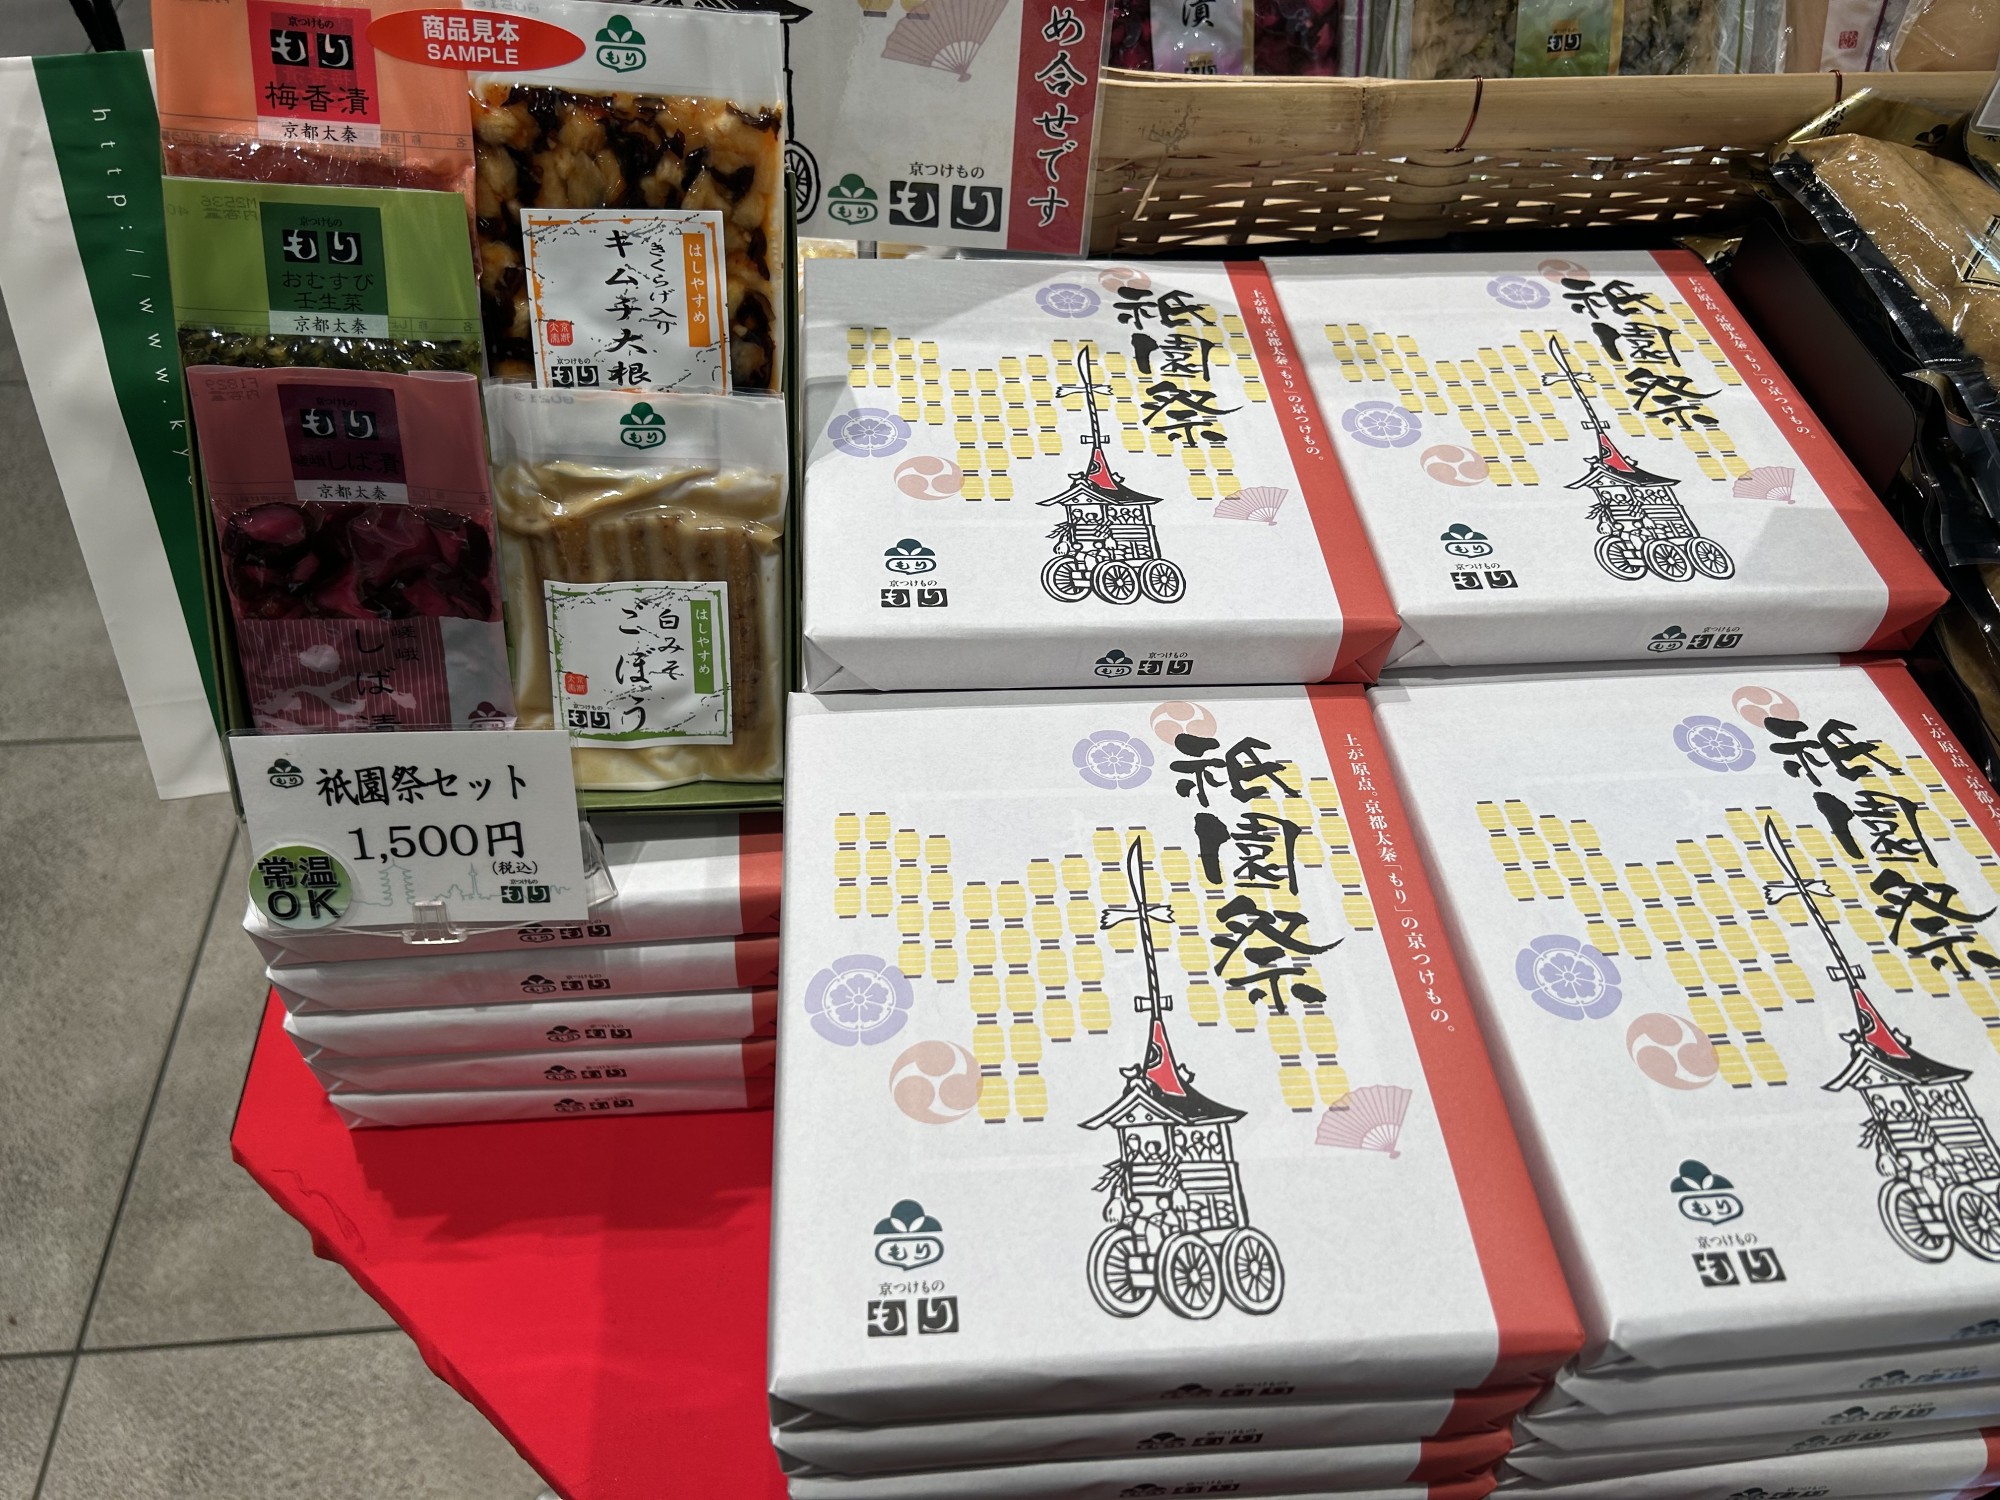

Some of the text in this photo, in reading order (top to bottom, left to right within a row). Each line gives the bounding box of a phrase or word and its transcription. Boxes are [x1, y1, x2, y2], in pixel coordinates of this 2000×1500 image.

[288, 15, 334, 29] 京つけもの
[422, 15, 520, 45] 商品見本
[270, 28, 354, 70] もり
[427, 43, 519, 65] SAMPLE
[605, 50, 637, 66] もり
[265, 81, 370, 115] 梅香漬
[1027, 5, 1087, 227] め合せです
[281, 121, 358, 144] 京都太秦
[909, 161, 985, 179] 京つけもの
[837, 206, 869, 219] もり
[889, 180, 1003, 233] もり
[300, 216, 342, 227] 京つけもの
[282, 229, 363, 265] もり
[282, 271, 374, 291] おむすび
[649, 238, 677, 335] きくらげ入り
[689, 244, 706, 324] はしやすめ
[294, 292, 363, 311] 壬生菜
[604, 230, 652, 385] キムチ大根
[294, 315, 368, 334] 京都太秦
[556, 356, 591, 365] 京つけもの
[1561, 277, 1722, 431] 祇園祭
[551, 365, 599, 387] もり
[1113, 286, 1244, 447] 祇園祭
[301, 409, 379, 441] もり
[317, 484, 387, 501] 京都太秦
[1454, 562, 1500, 570] 京つけもの
[889, 579, 937, 588] 京つけもの
[1450, 570, 1519, 591] もり
[880, 588, 948, 608] もり
[659, 608, 684, 680] 白みそ
[696, 608, 711, 675] はしやすめ
[1686, 633, 1743, 650] もり
[615, 600, 655, 731] ごぼう
[1147, 651, 1188, 659] 京つけもの
[1137, 659, 1194, 676] もり
[568, 709, 610, 729] もり
[316, 764, 527, 806] 祇園祭セット
[348, 820, 526, 865] 1,500円
[1764, 716, 2000, 980] 祇園祭
[257, 856, 338, 890] 常温
[1169, 733, 1345, 1014] 祇園祭
[267, 890, 343, 921] OK
[501, 885, 551, 904] もり
[1691, 1199, 1732, 1216] もり
[1696, 1232, 1758, 1248] 京つけもの
[888, 1243, 931, 1260] もり
[1691, 1247, 1787, 1287] もり
[879, 1280, 945, 1296] 京つけもの
[867, 1295, 959, 1337] もり
